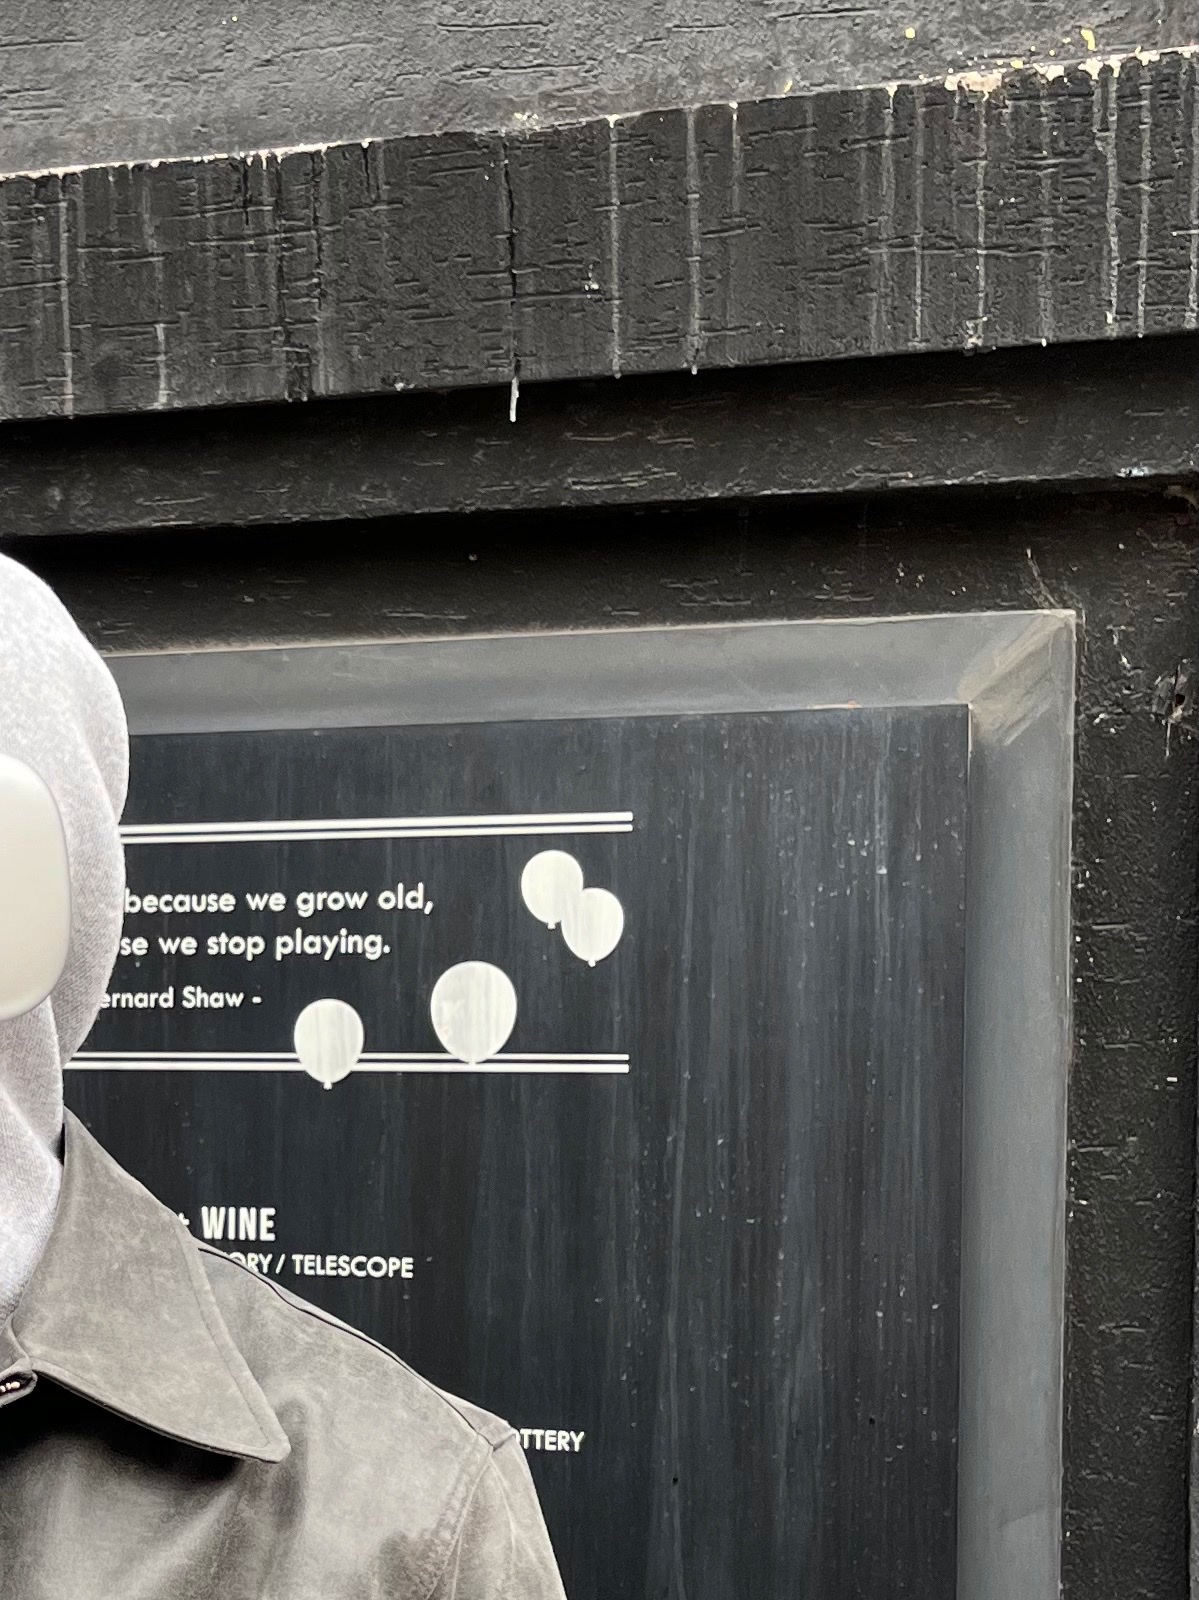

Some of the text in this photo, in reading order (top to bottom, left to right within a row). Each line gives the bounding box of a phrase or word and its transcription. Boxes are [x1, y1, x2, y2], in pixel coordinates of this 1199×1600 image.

[125, 881, 434, 918] because we grow old,
[158, 936, 198, 956] we
[208, 931, 266, 962] stop
[275, 926, 391, 962] playing.
[181, 985, 244, 1009] Shaw
[200, 1205, 277, 1242] WINE
[291, 1253, 414, 1279] TELESCOPE
[515, 1425, 585, 1452] TTERY
